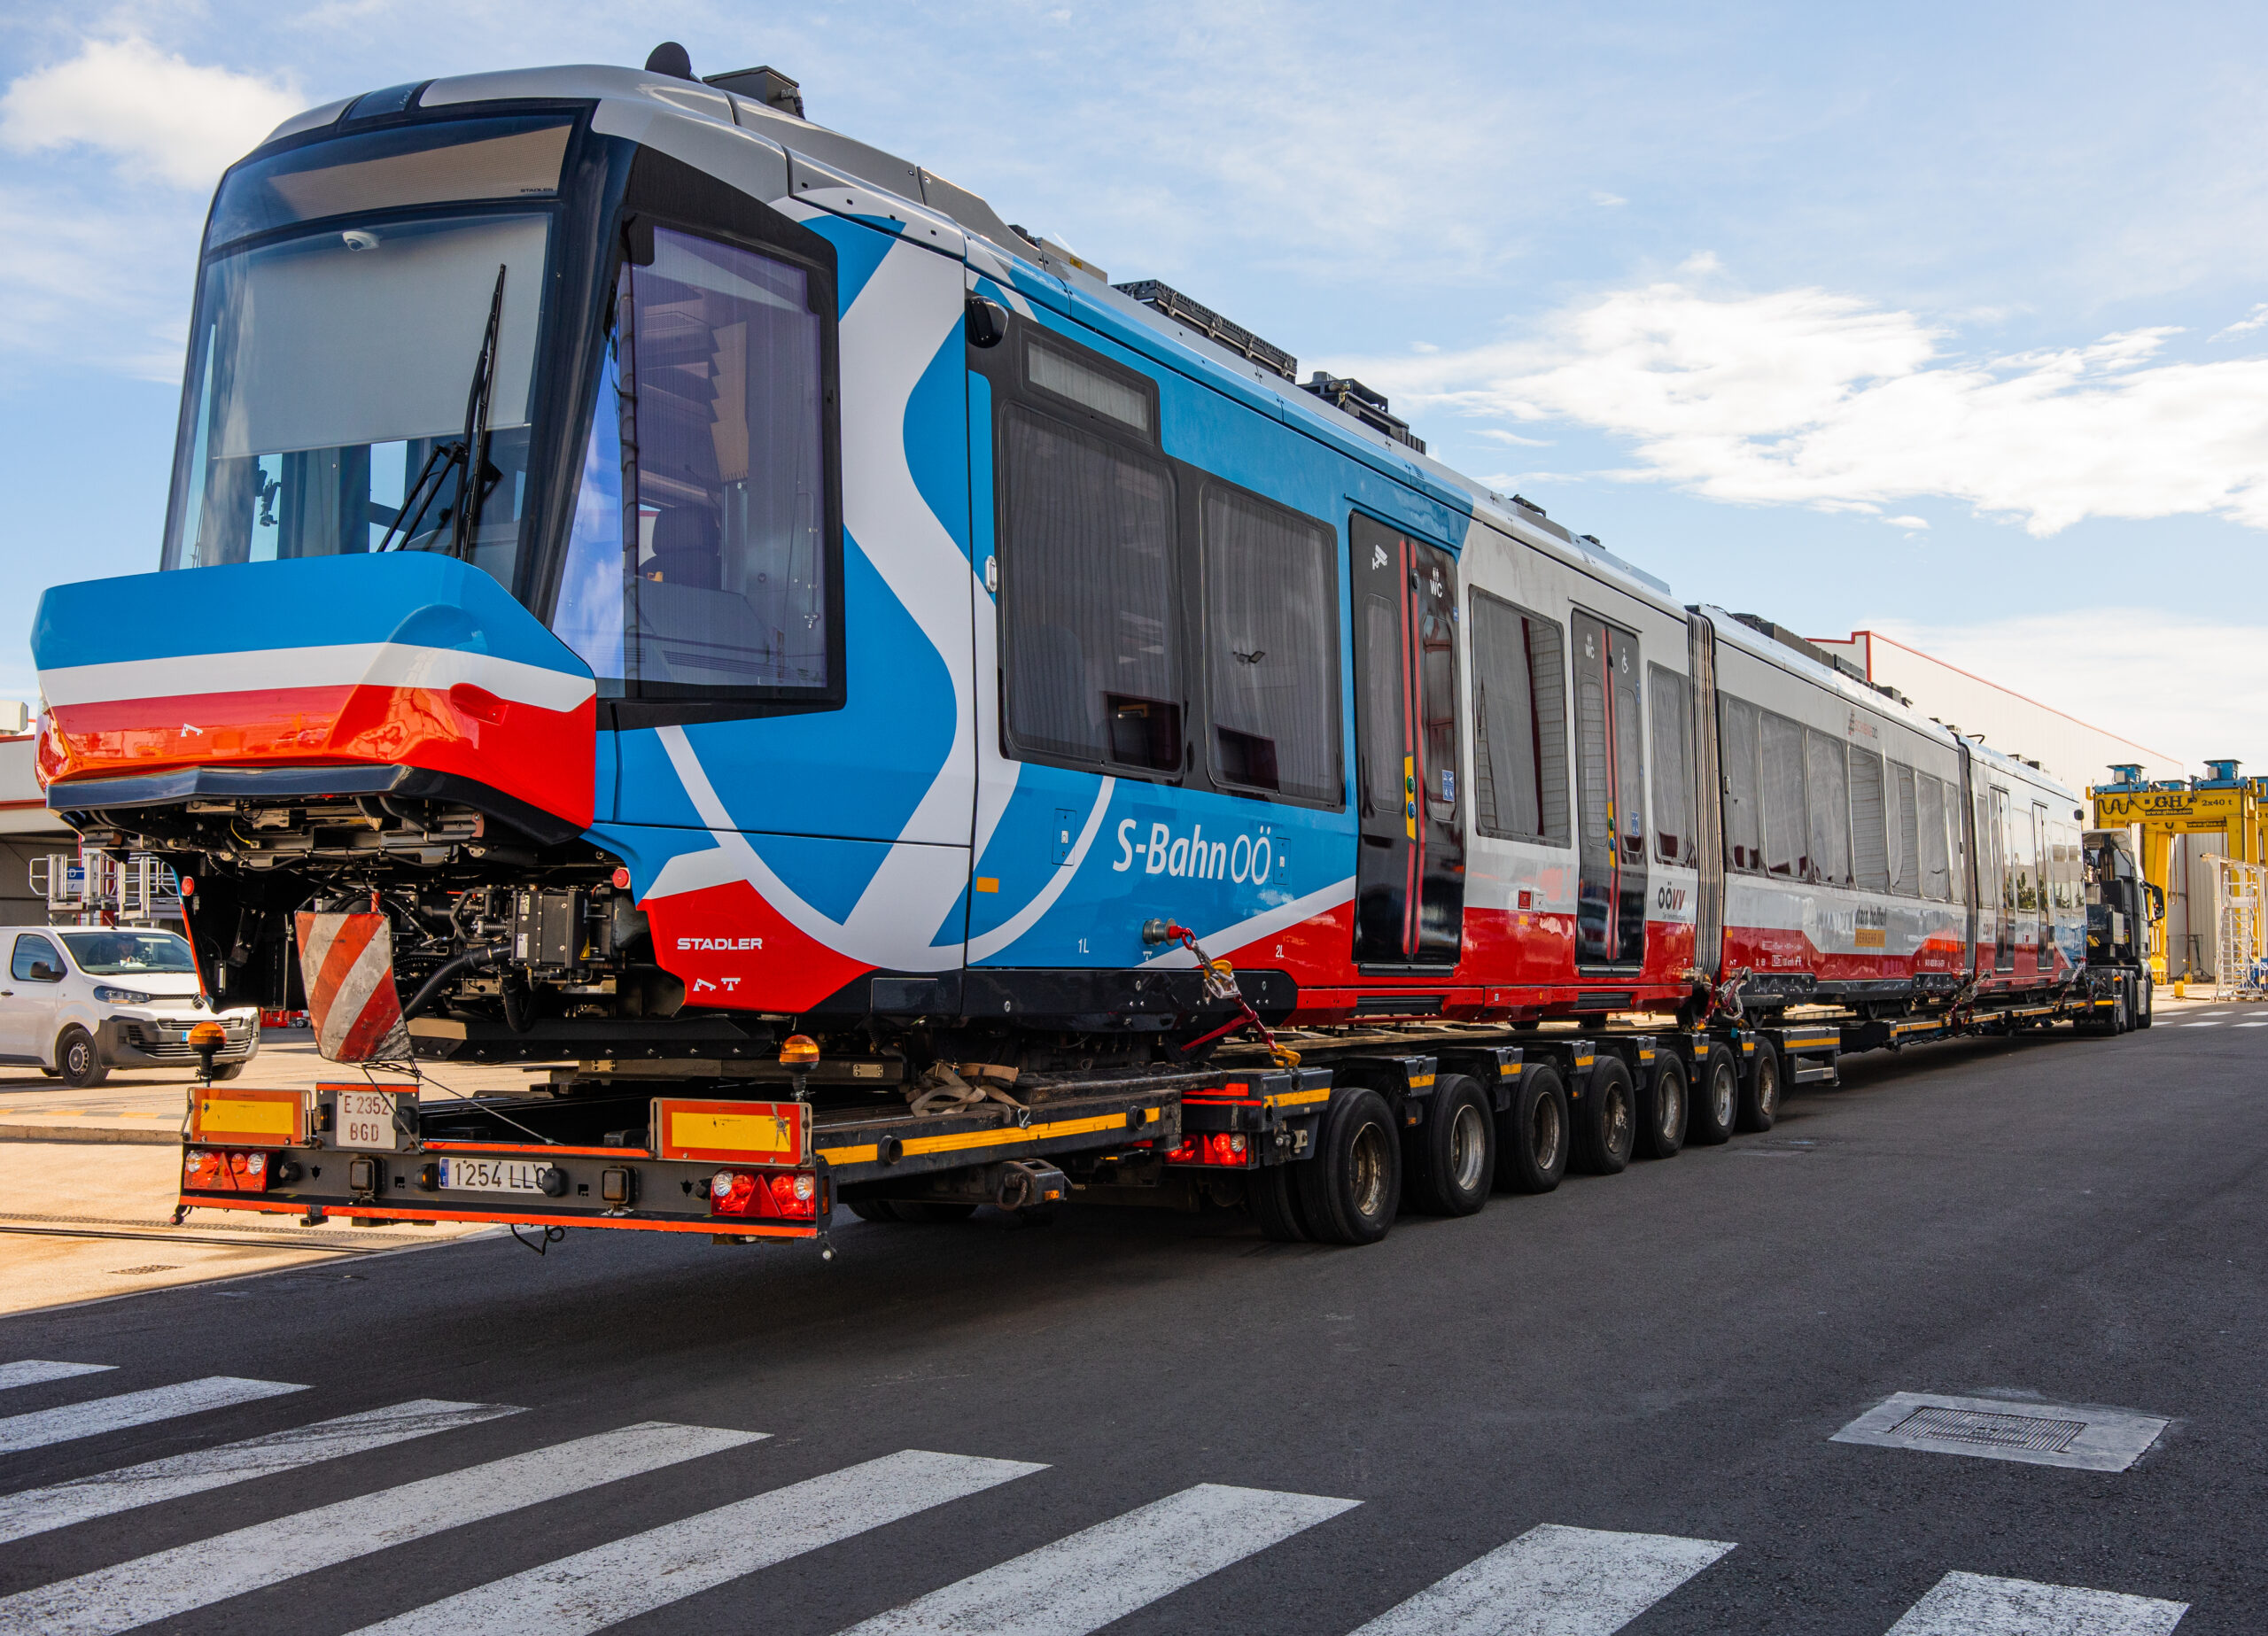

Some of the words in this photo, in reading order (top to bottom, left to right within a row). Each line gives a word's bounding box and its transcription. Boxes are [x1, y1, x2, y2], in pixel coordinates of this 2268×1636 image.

[1429, 578, 1443, 598] WC
[1584, 643, 1595, 659] WC
[2154, 795, 2183, 808] GH
[1112, 818, 1227, 880] S-Bahn
[1231, 825, 1272, 886] OÖ
[1658, 880, 1686, 911] OÖVV
[677, 937, 763, 950] STADLER
[1078, 938, 1090, 954] 1L
[1276, 944, 1285, 958] 2L
[344, 1095, 353, 1113] E
[356, 1096, 390, 1116] 2352
[350, 1121, 379, 1143] BGD
[455, 1162, 502, 1188] 1254
